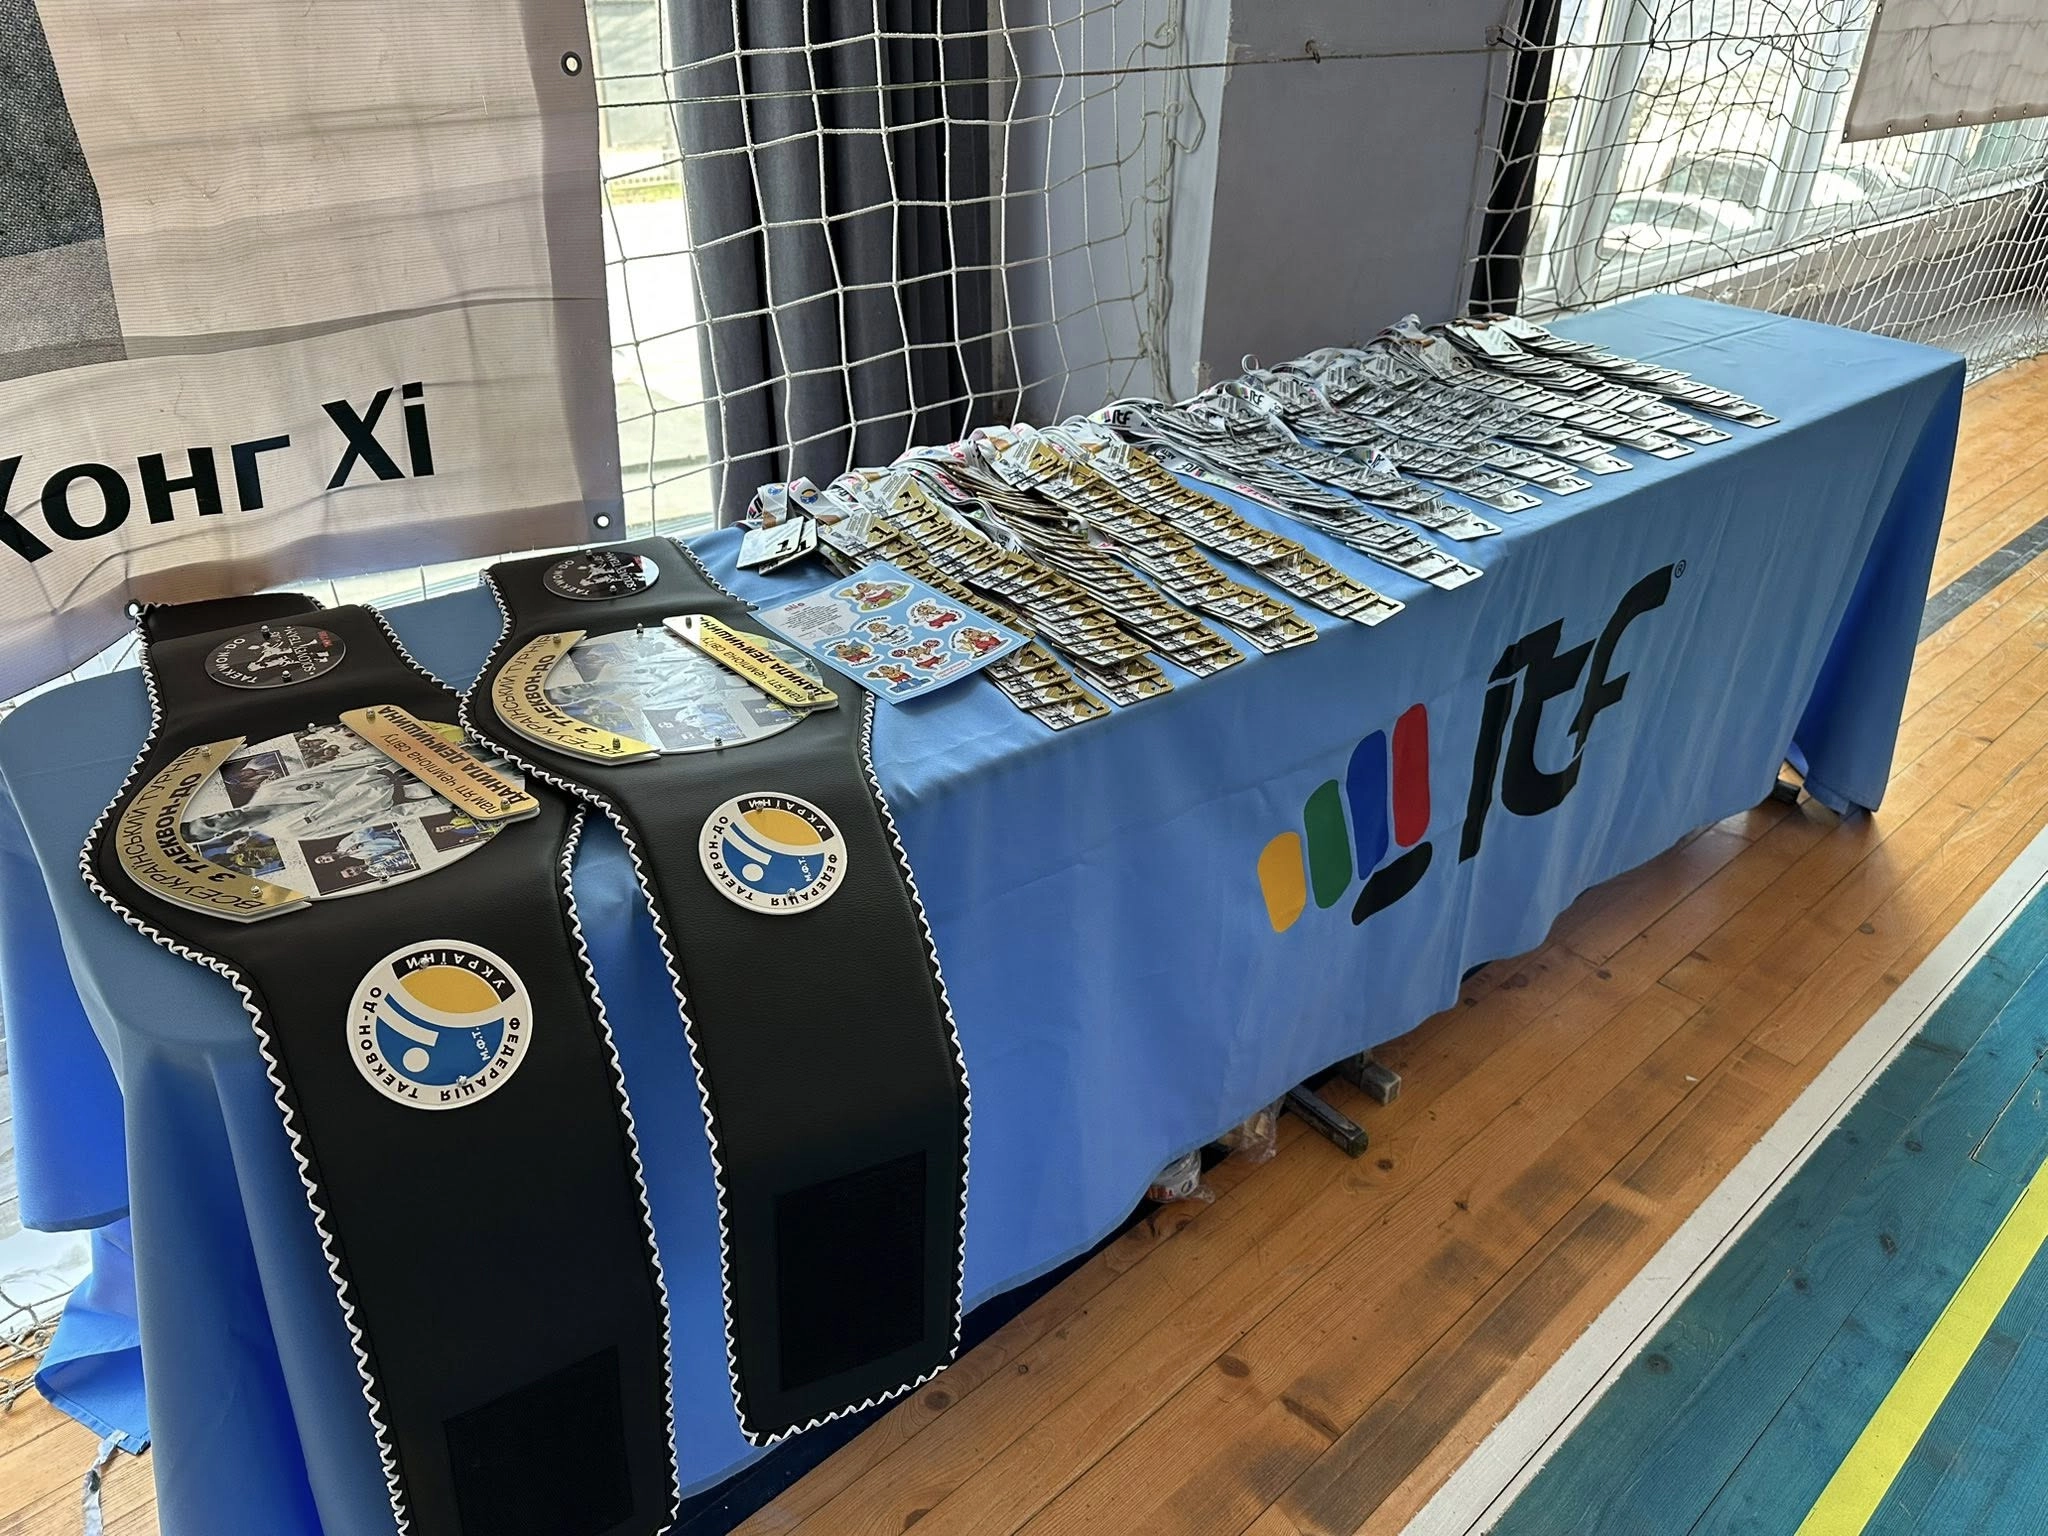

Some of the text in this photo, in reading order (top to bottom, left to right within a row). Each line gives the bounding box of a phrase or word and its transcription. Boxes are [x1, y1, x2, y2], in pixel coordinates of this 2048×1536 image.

[321, 381, 435, 490] Хі
[378, 706, 530, 805] ДАНИЛА ДЕМЧИШИНА
[380, 733, 407, 753] світу
[407, 751, 457, 787] чемпіона
[123, 747, 266, 911] ВСЕУКРАЇНСЬКИЙ ТУРНІР
[155, 773, 209, 874] ТАЕКВОН-ДО
[709, 816, 753, 900] ТАЕКВОН-ДО
[771, 853, 838, 906] ФЕДЕРАЦІЯ
[359, 952, 520, 1101] ФЕДЕРАЦІЯ ТАЕКВОН-ДО УКРАЇНИ
